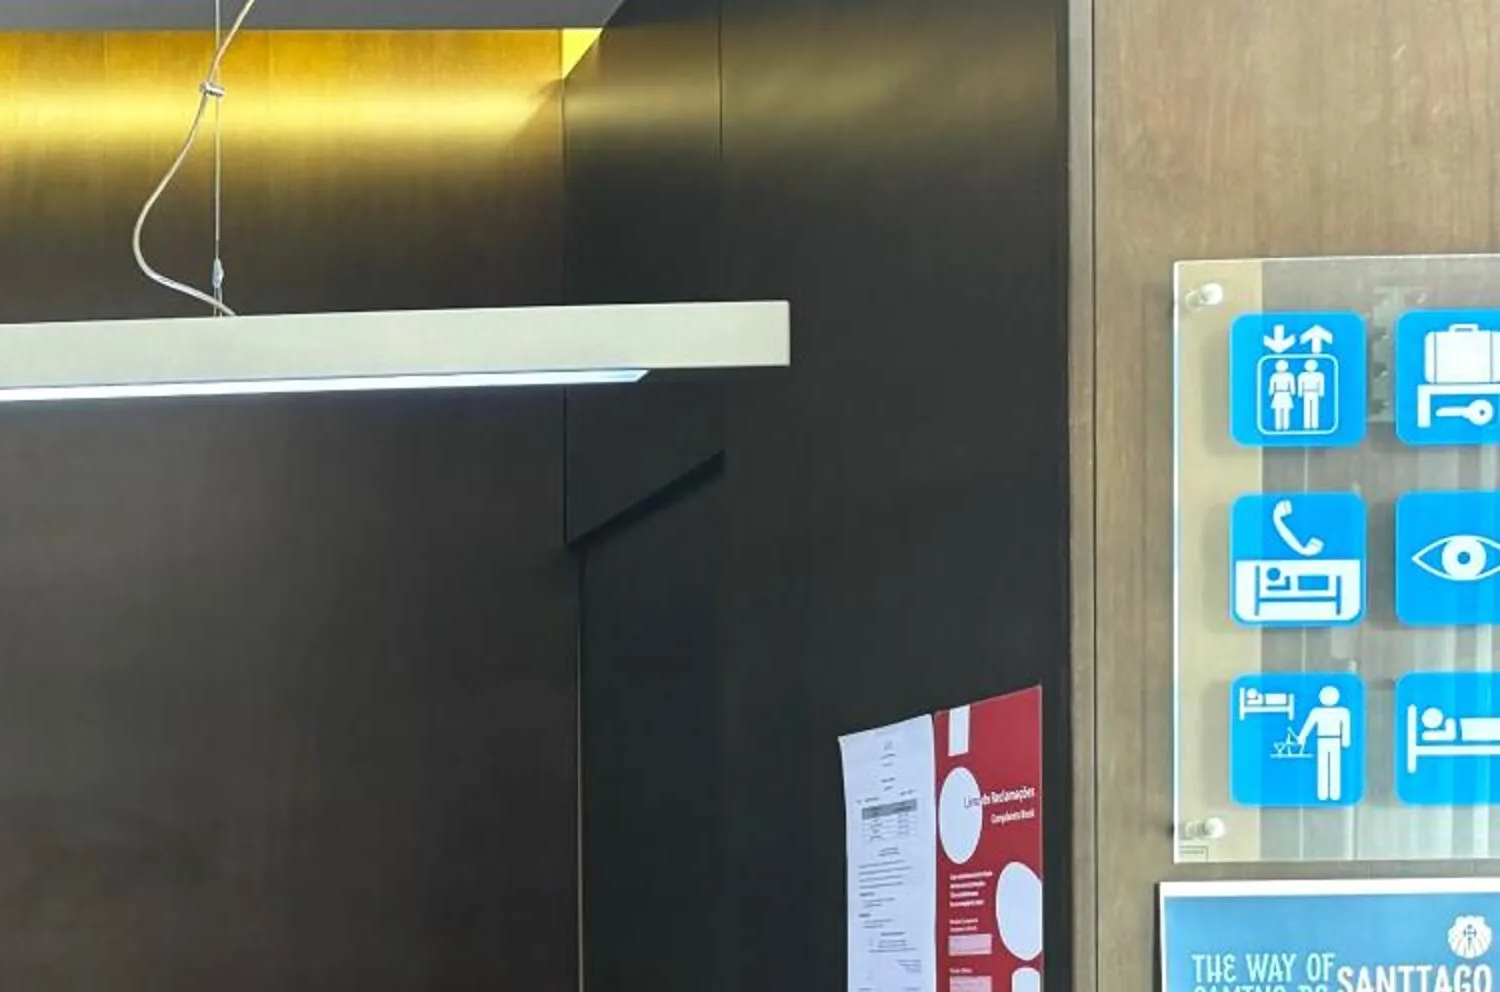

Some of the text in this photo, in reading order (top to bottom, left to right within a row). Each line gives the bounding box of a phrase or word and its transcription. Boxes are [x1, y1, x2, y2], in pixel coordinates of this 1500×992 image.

[1192, 952, 1336, 983] THE WAY OF
